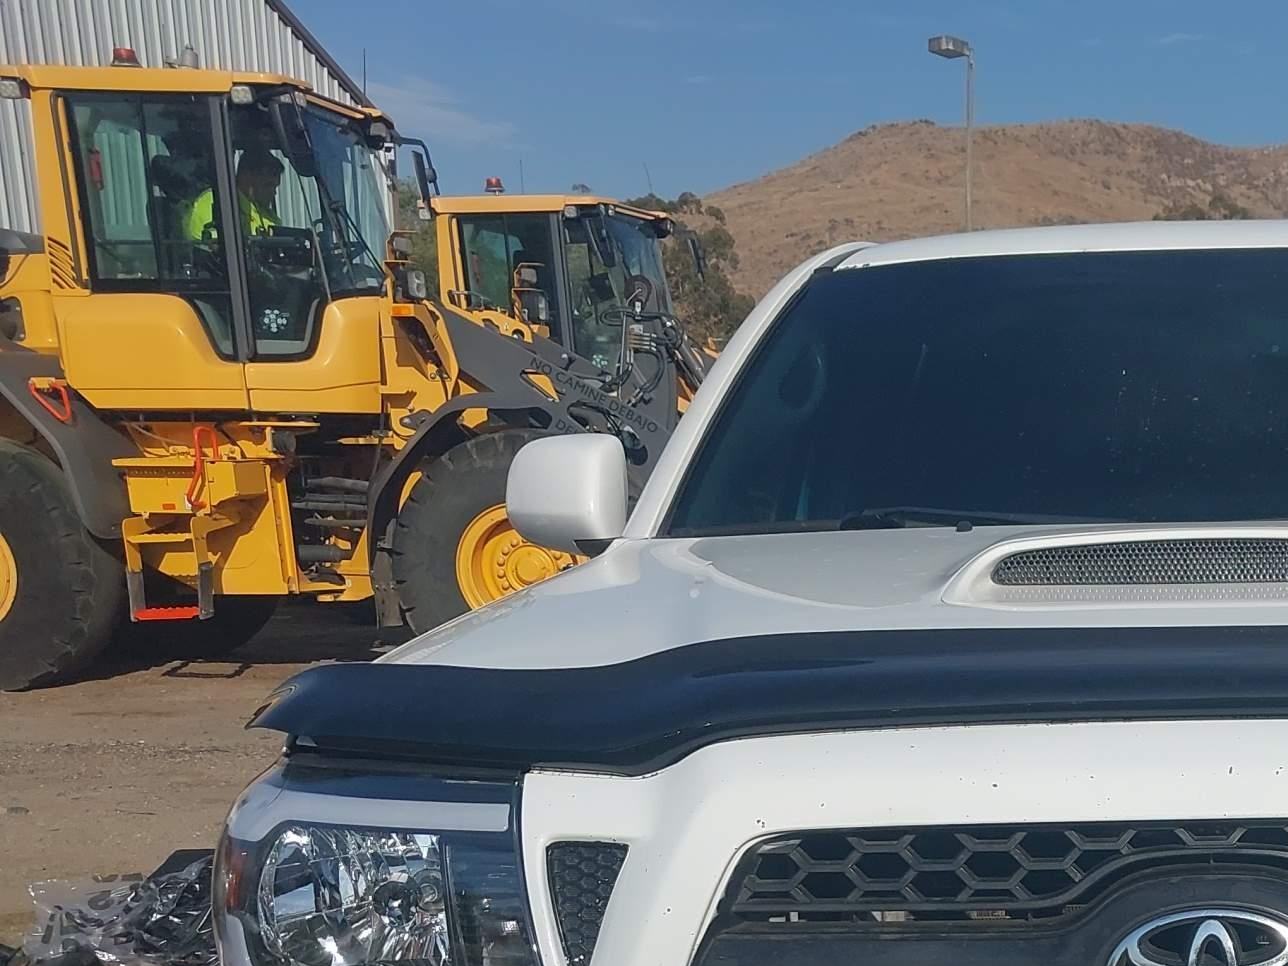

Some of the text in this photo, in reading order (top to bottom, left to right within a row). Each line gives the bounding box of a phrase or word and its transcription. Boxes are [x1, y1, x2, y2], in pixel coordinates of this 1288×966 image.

[529, 357, 658, 433] NO CAMINE DEBAJO
